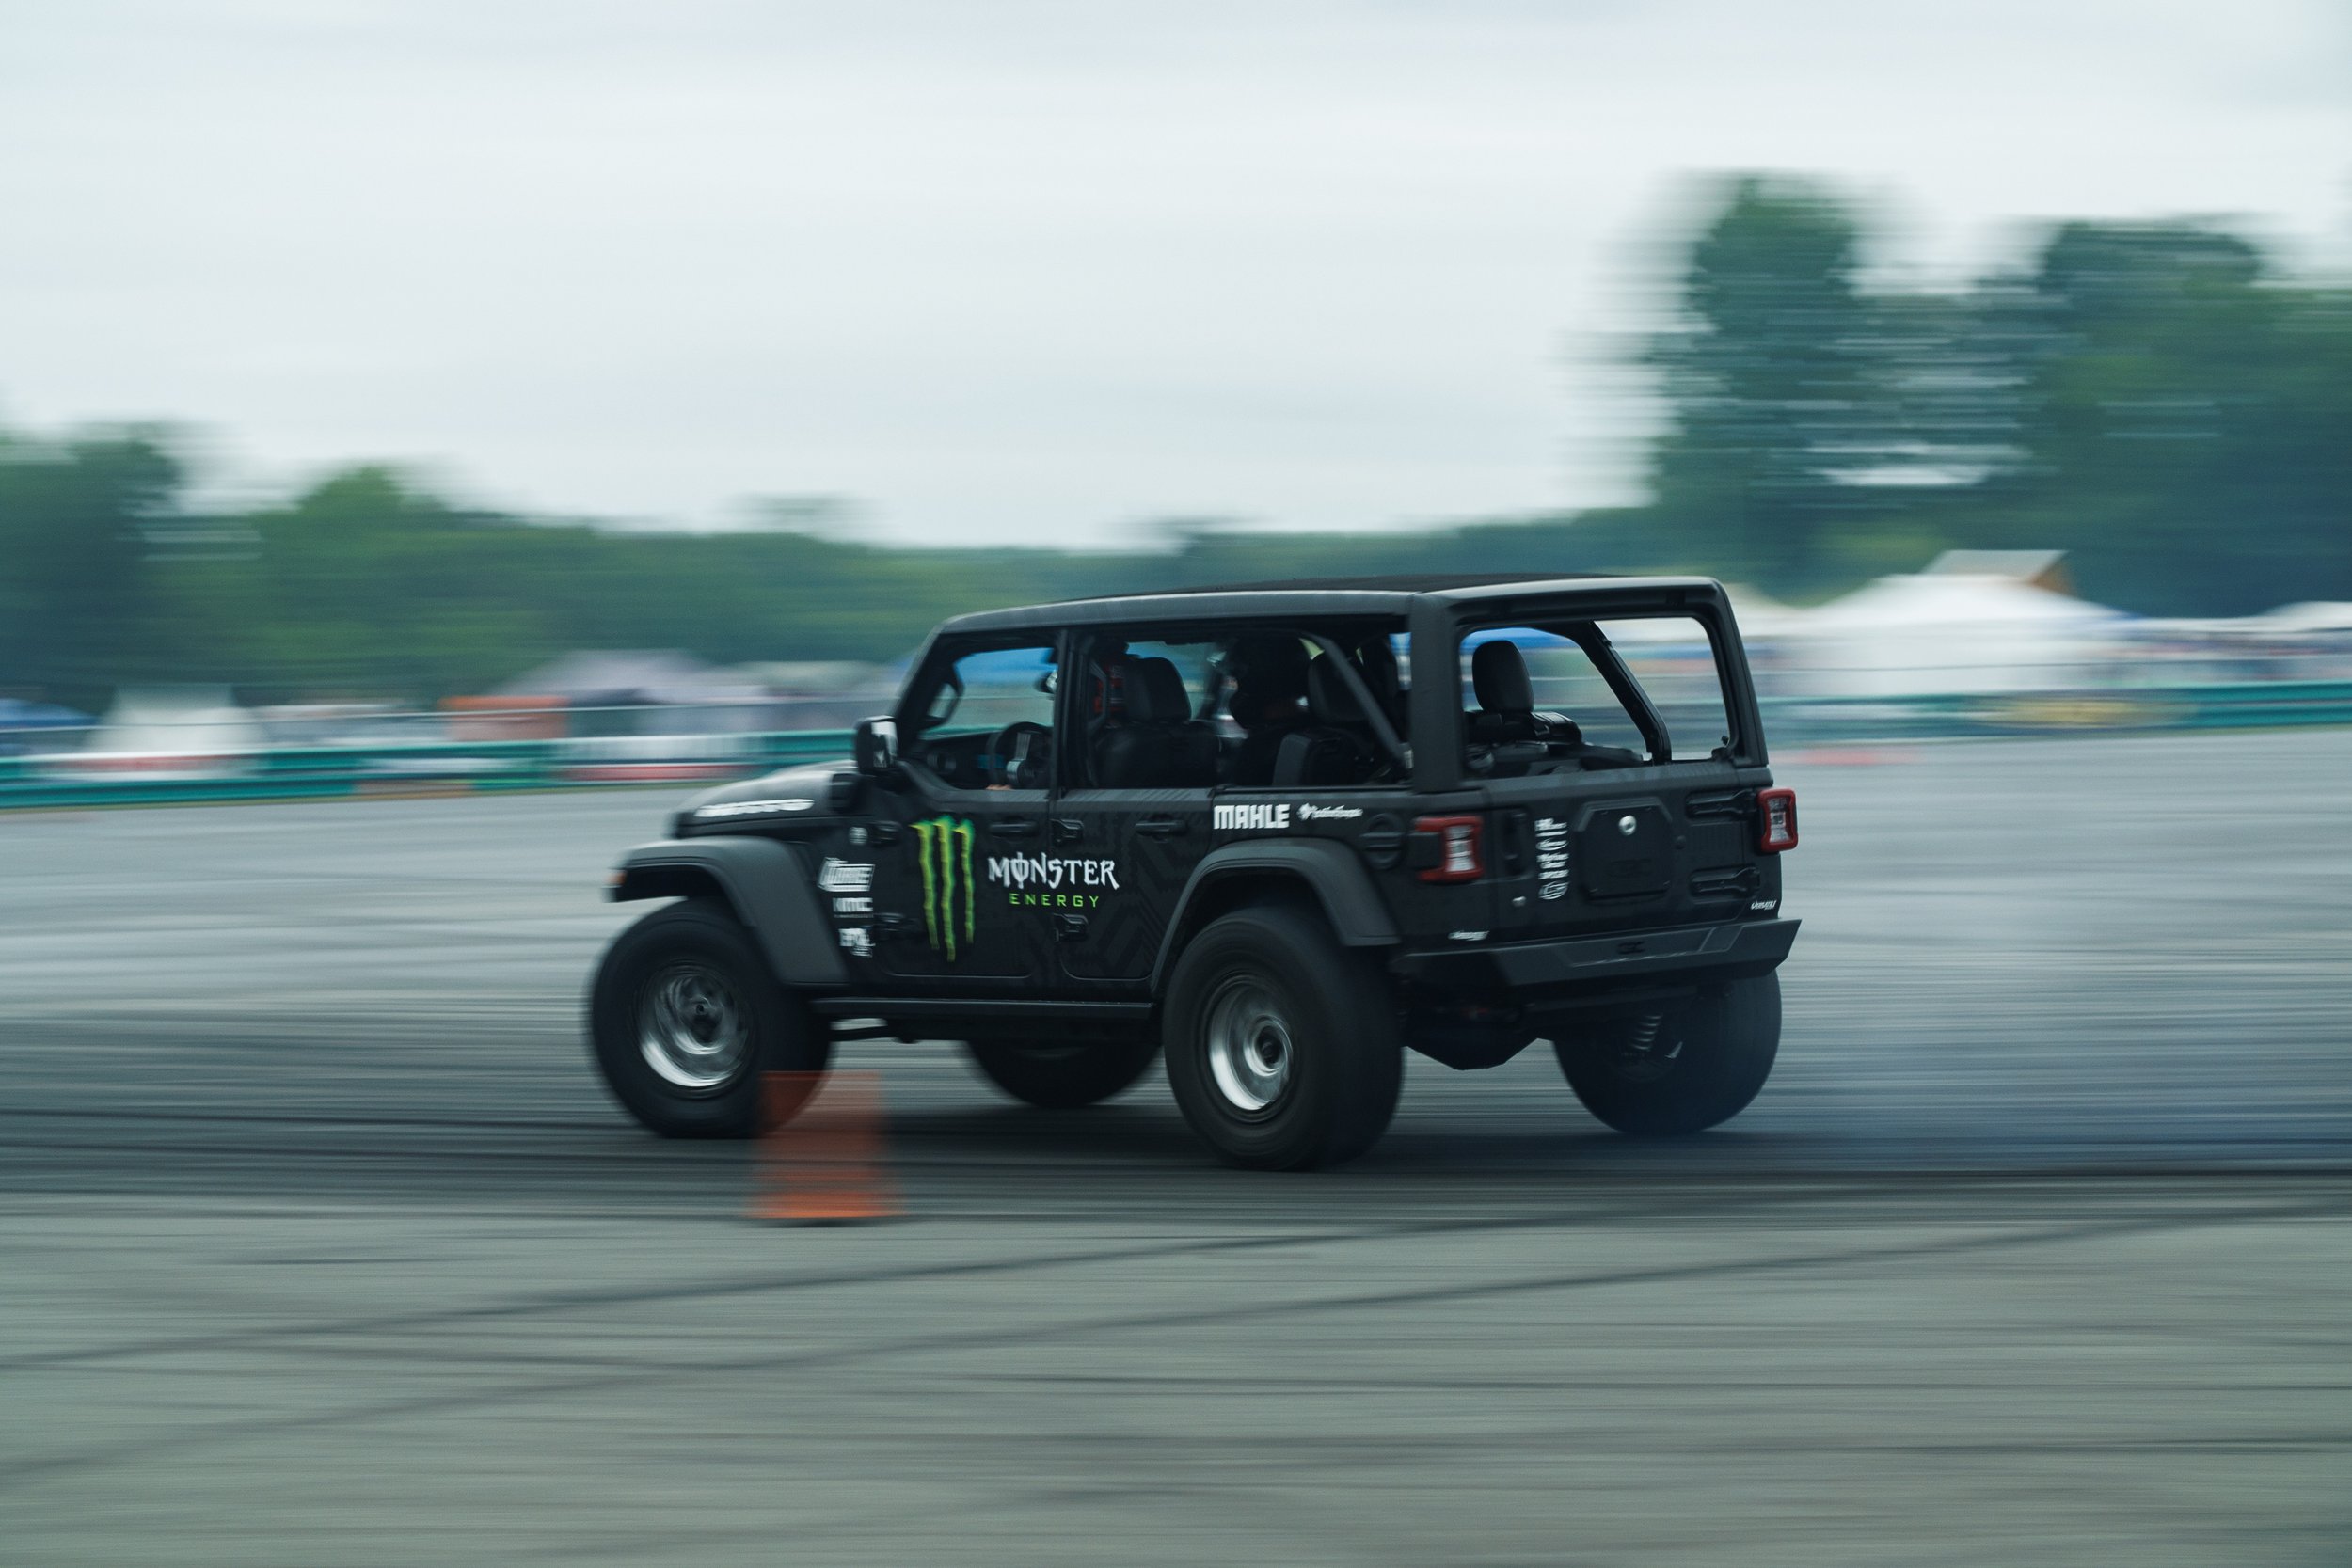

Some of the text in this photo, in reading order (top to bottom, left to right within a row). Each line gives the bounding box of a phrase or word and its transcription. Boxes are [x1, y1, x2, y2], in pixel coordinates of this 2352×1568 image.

[1214, 804, 1290, 829] MAHLE
[988, 851, 1120, 890] MONSTER
[1009, 893, 1099, 908] ENERGY
